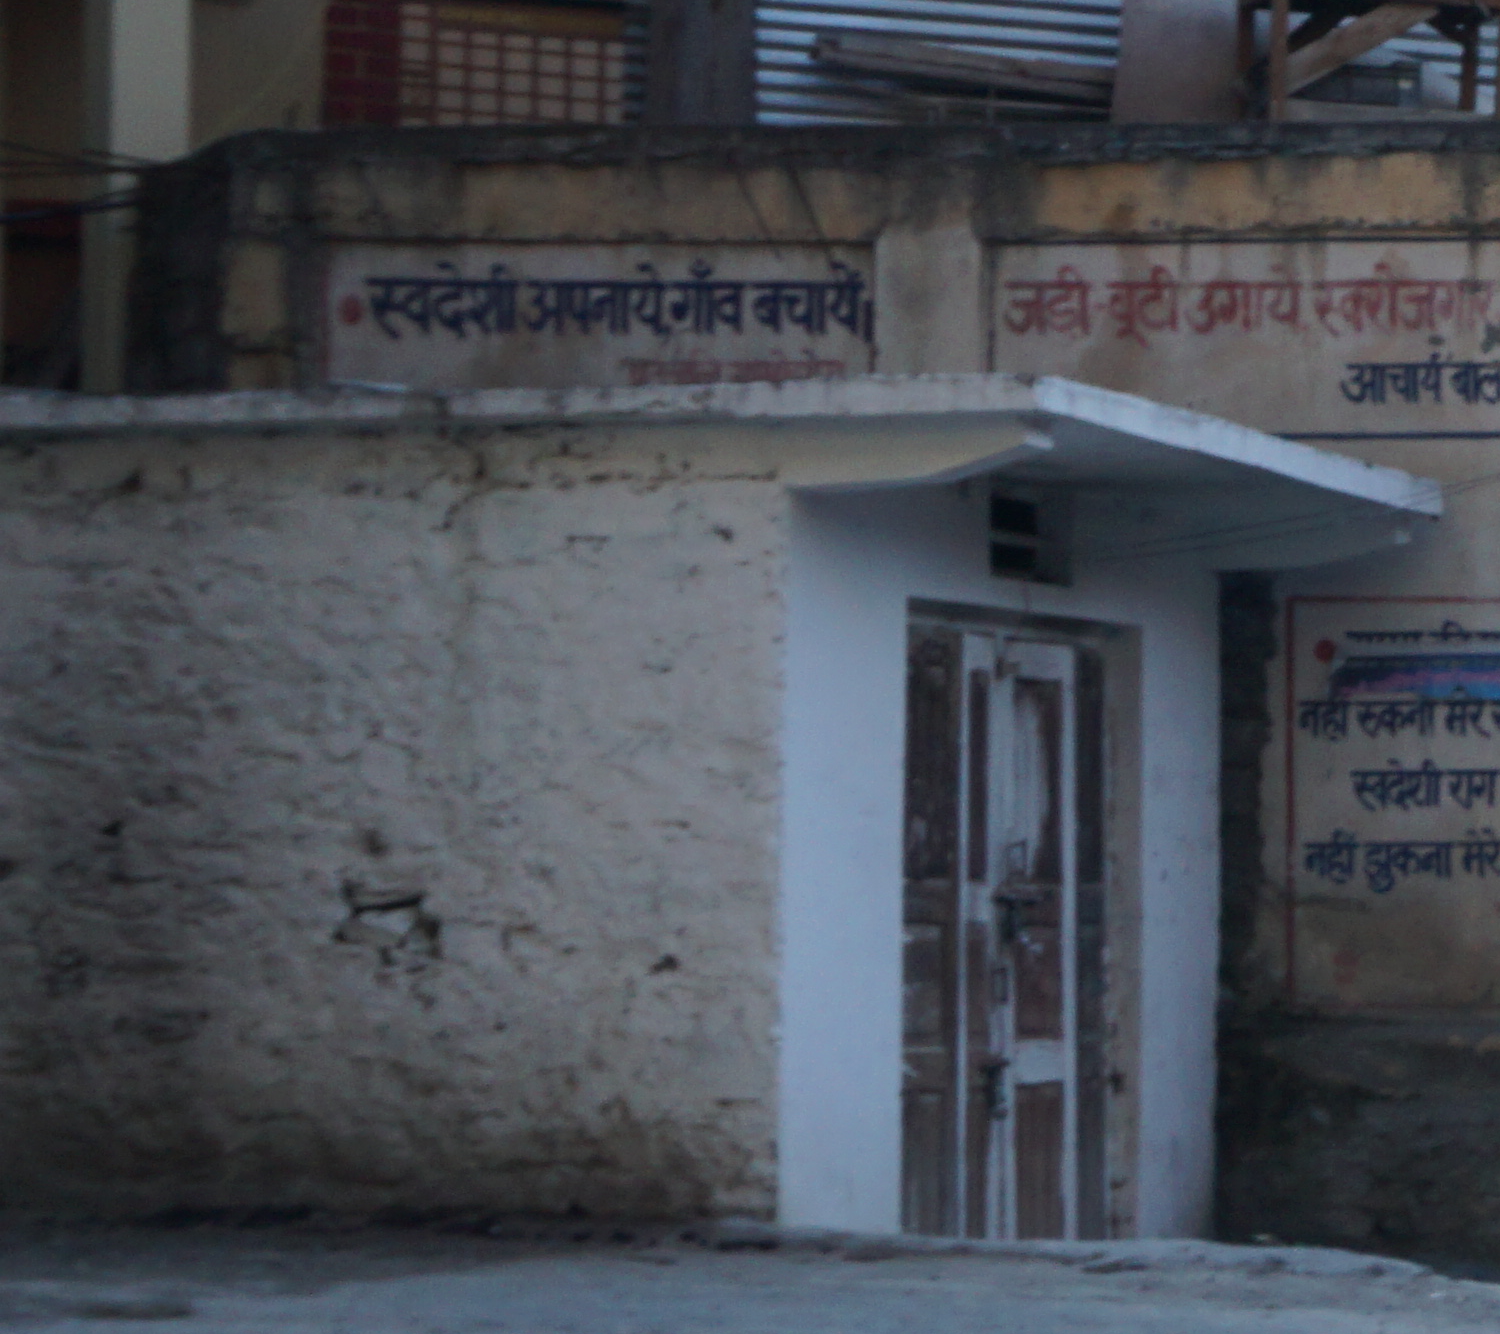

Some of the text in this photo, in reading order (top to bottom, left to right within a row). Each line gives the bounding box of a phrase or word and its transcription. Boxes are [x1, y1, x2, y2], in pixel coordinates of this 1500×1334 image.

[365, 262, 519, 340] स्वदेशी
[1341, 352, 1442, 405] आचार्य
[1351, 757, 1440, 811] स्वदेशी
[1446, 767, 1495, 807] राग
